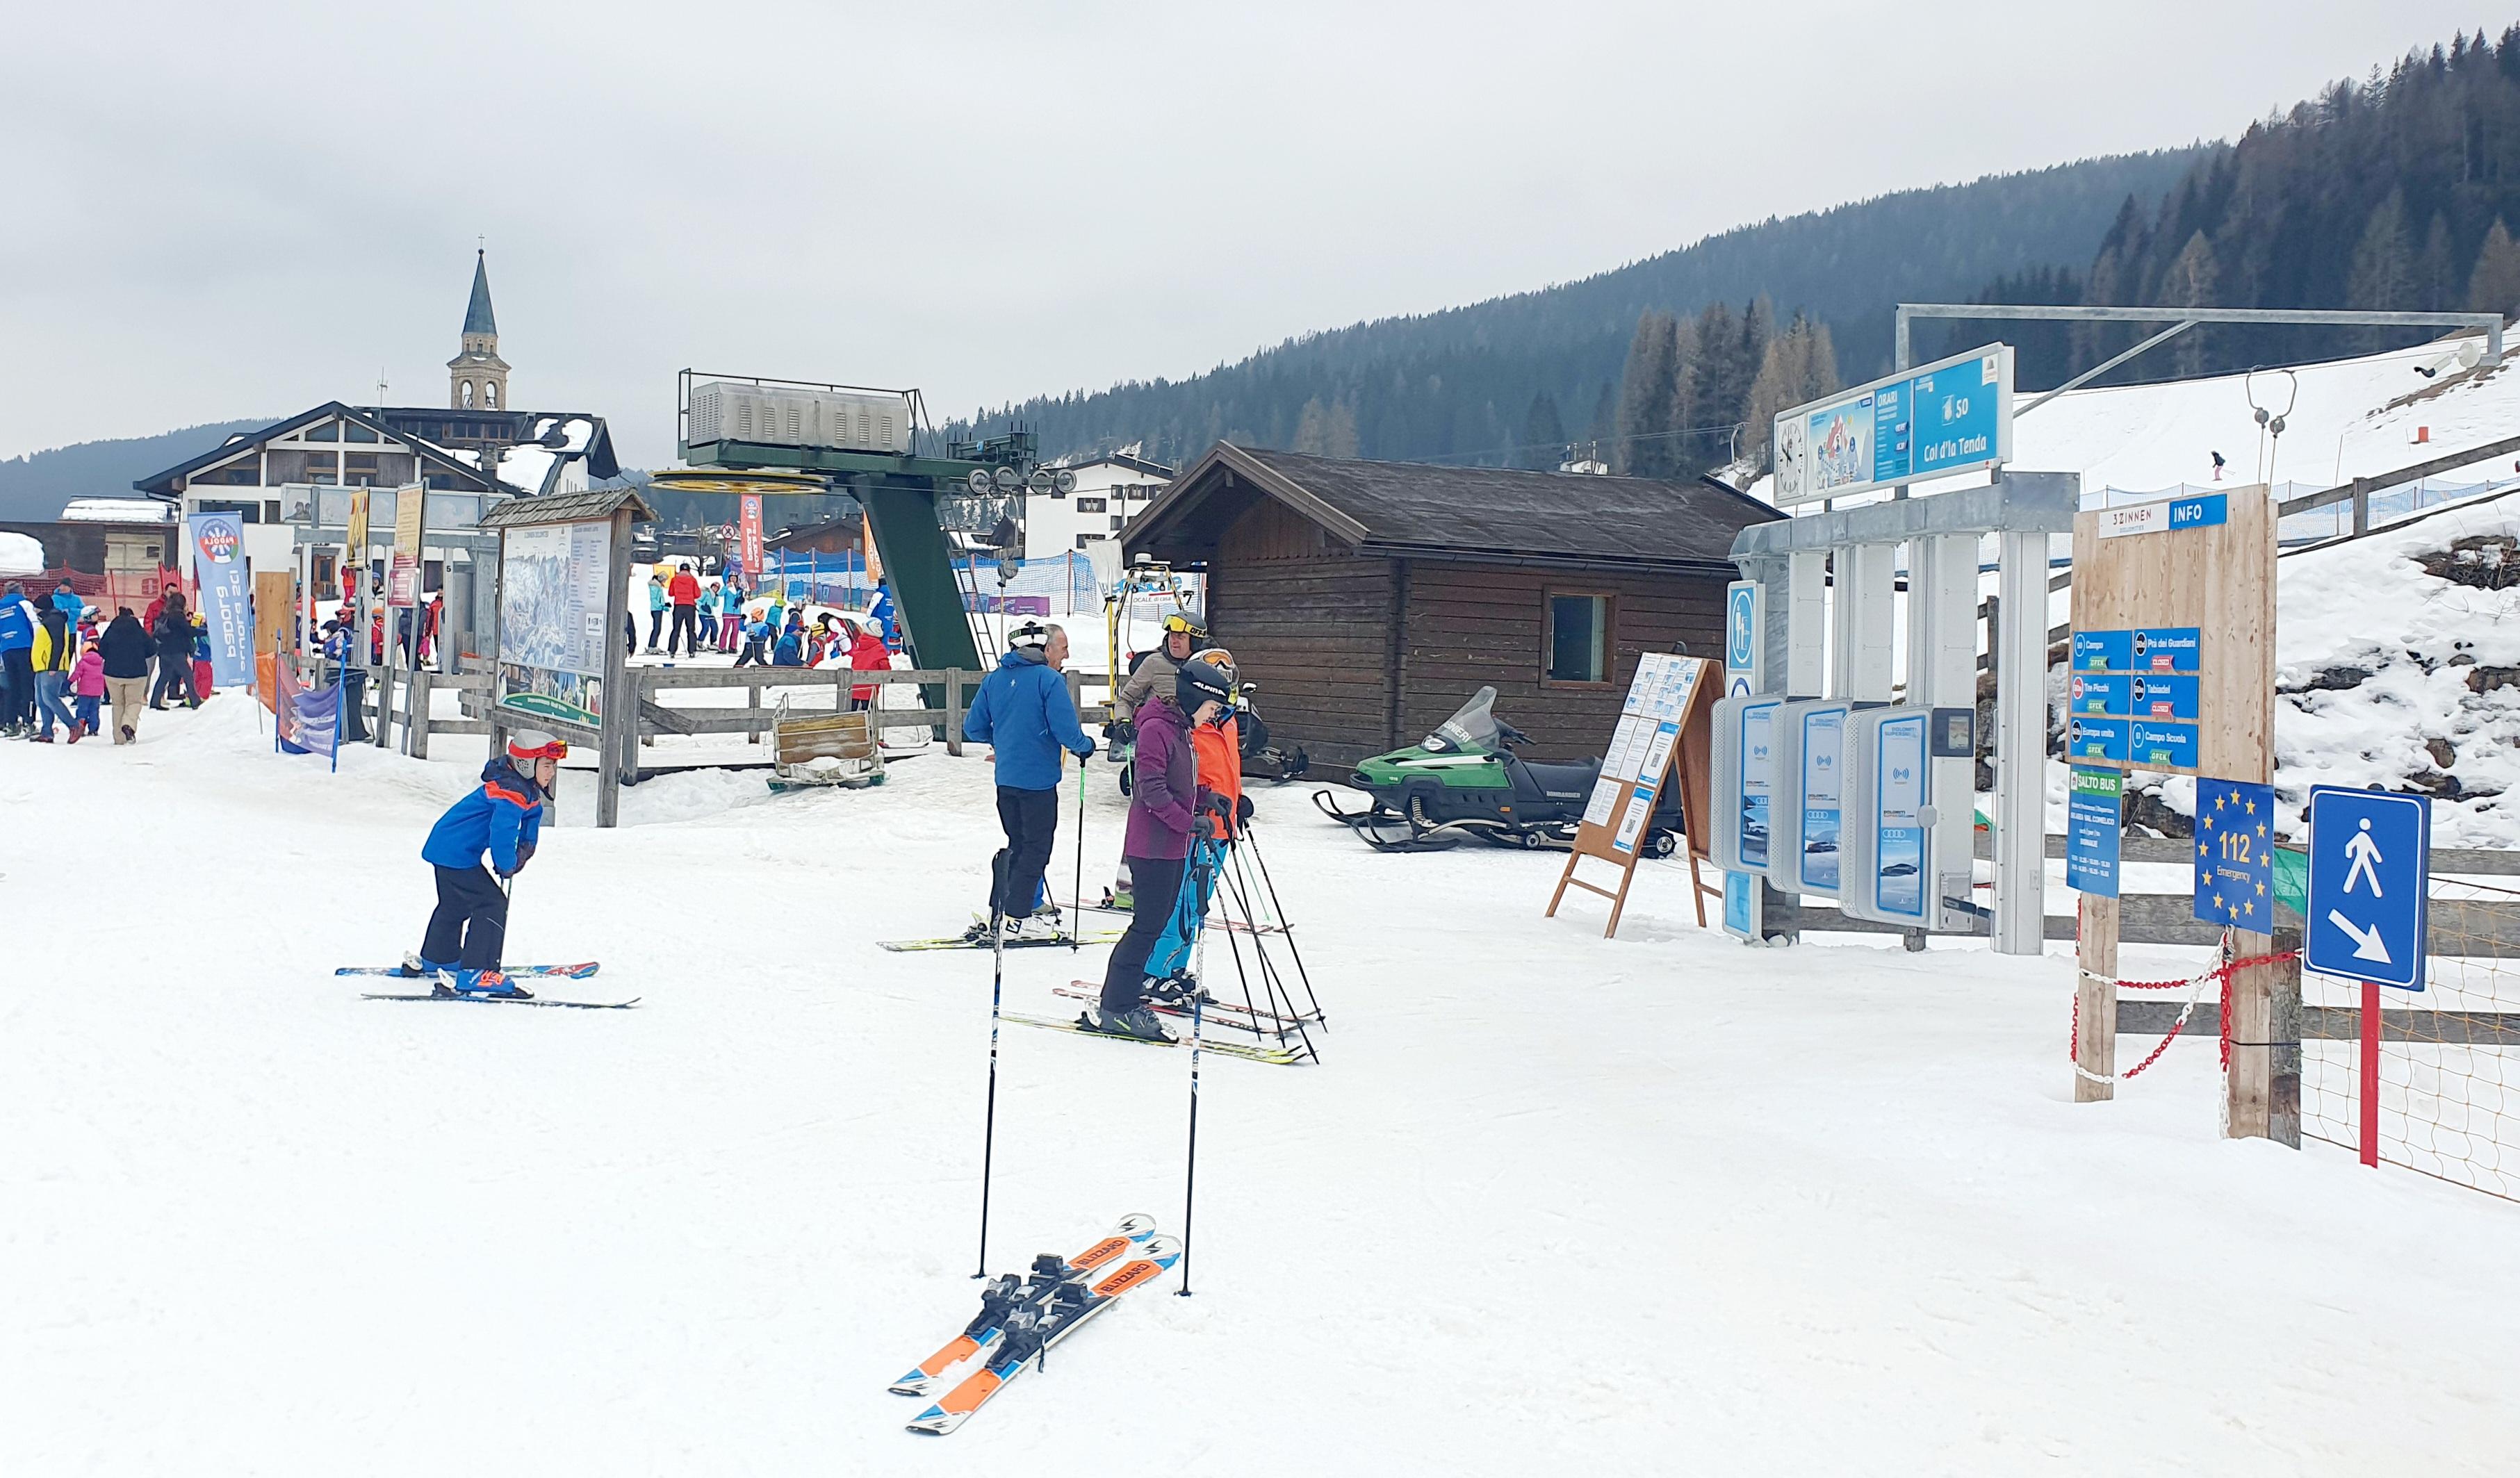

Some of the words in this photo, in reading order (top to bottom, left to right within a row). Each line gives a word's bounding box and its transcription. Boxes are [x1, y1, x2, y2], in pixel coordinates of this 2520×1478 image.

[1878, 391, 1897, 407] ORARI
[1956, 397, 1969, 419] 50
[1924, 443, 1938, 462] Col
[1940, 440, 1956, 458] d'la
[1958, 434, 1987, 455] Tenda
[2174, 504, 2202, 523] INFO
[2086, 641, 2104, 652] Campo
[2145, 732, 2165, 744] Campo
[2078, 775, 2098, 789] SALTO
[2100, 778, 2116, 791] BUS
[2219, 830, 2250, 864] 112
[2217, 865, 2251, 884] Emergency
[1077, 1240, 1125, 1266] BLIZZARD
[1101, 1263, 1150, 1292] BLIZZARD
